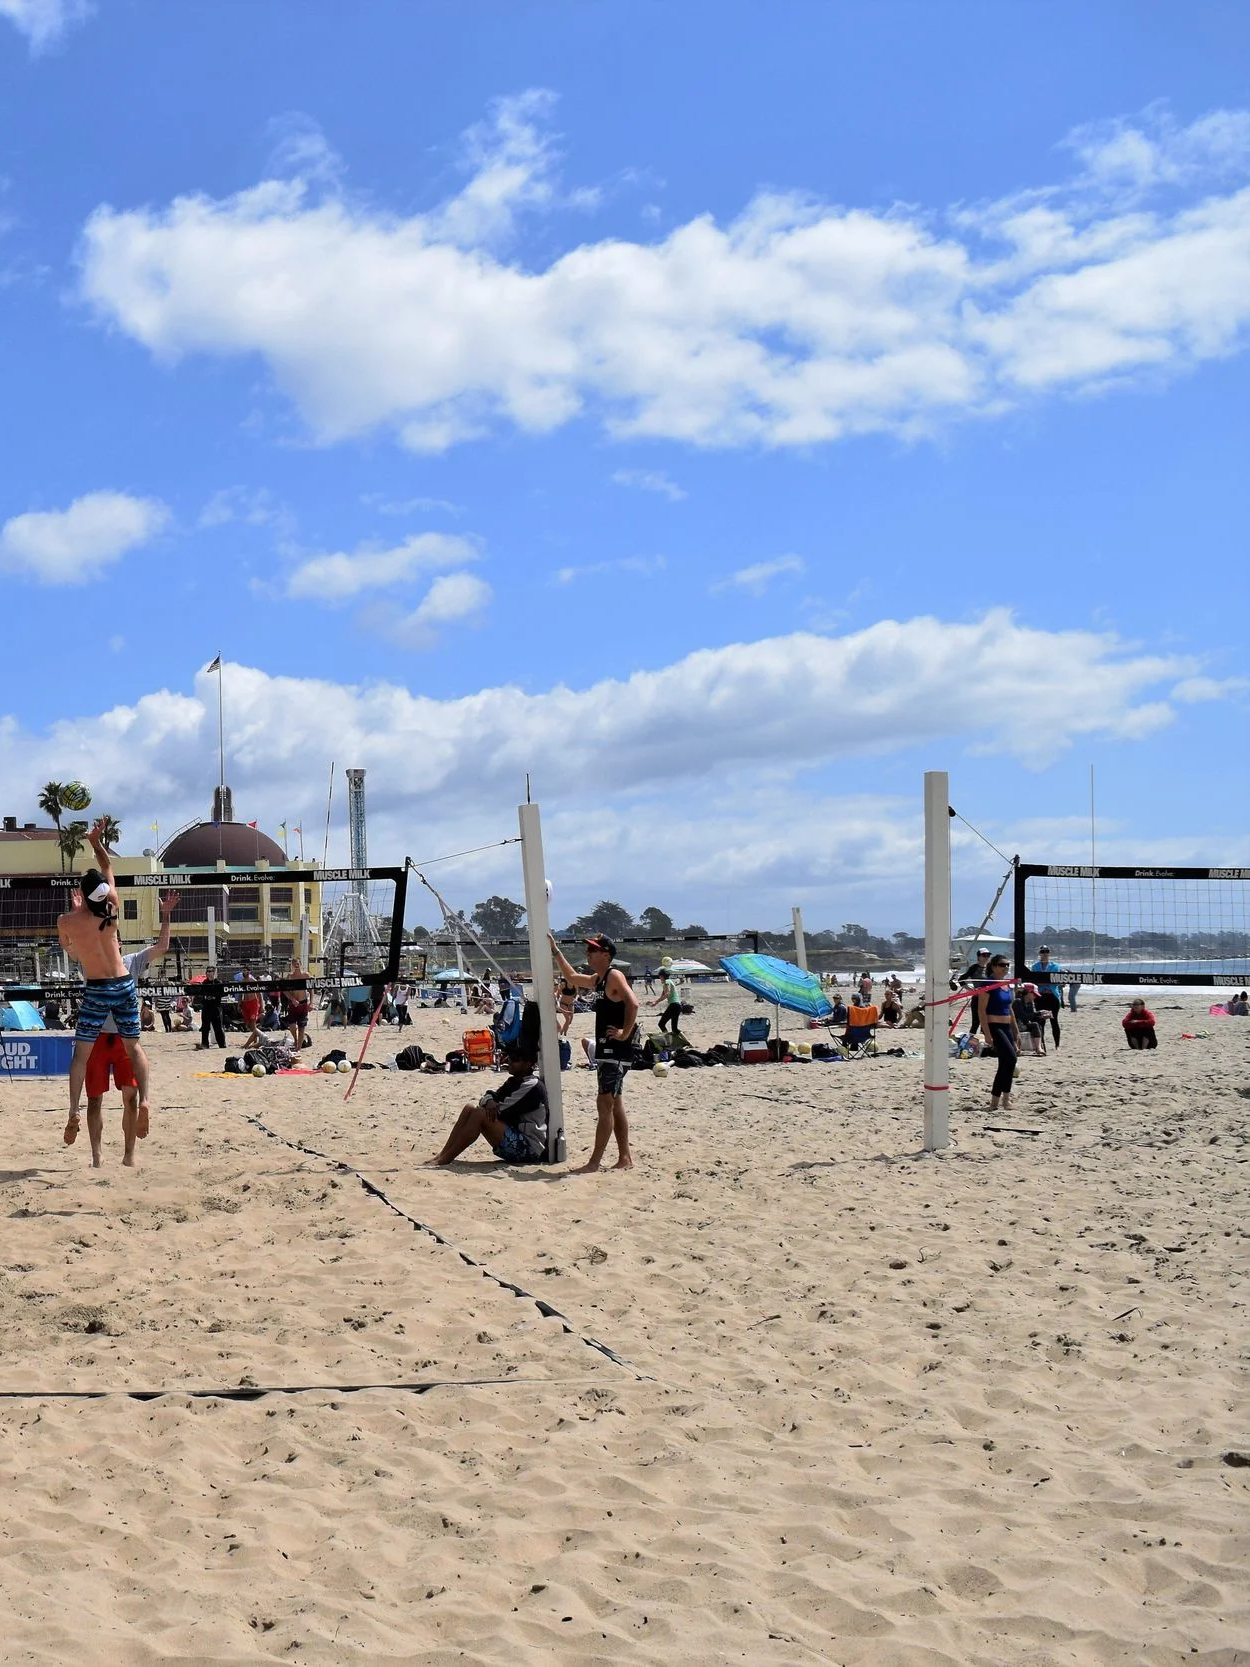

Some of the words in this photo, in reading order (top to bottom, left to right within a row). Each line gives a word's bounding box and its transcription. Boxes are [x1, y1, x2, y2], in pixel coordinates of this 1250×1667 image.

[313, 870, 347, 880] MUSCLE
[349, 869, 370, 879] MILK
[1048, 866, 1079, 877] MUSCLE
[1208, 869, 1239, 878] MUSCLE
[134, 875, 168, 885] MUSCLE
[170, 874, 191, 884] MILK
[306, 978, 340, 989] MUSCLE
[341, 977, 363, 987] MILK
[1050, 973, 1081, 983] MUSCLE
[1213, 976, 1244, 985] MUSCLE
[135, 987, 162, 997] USCLE
[164, 986, 185, 996] MILK
